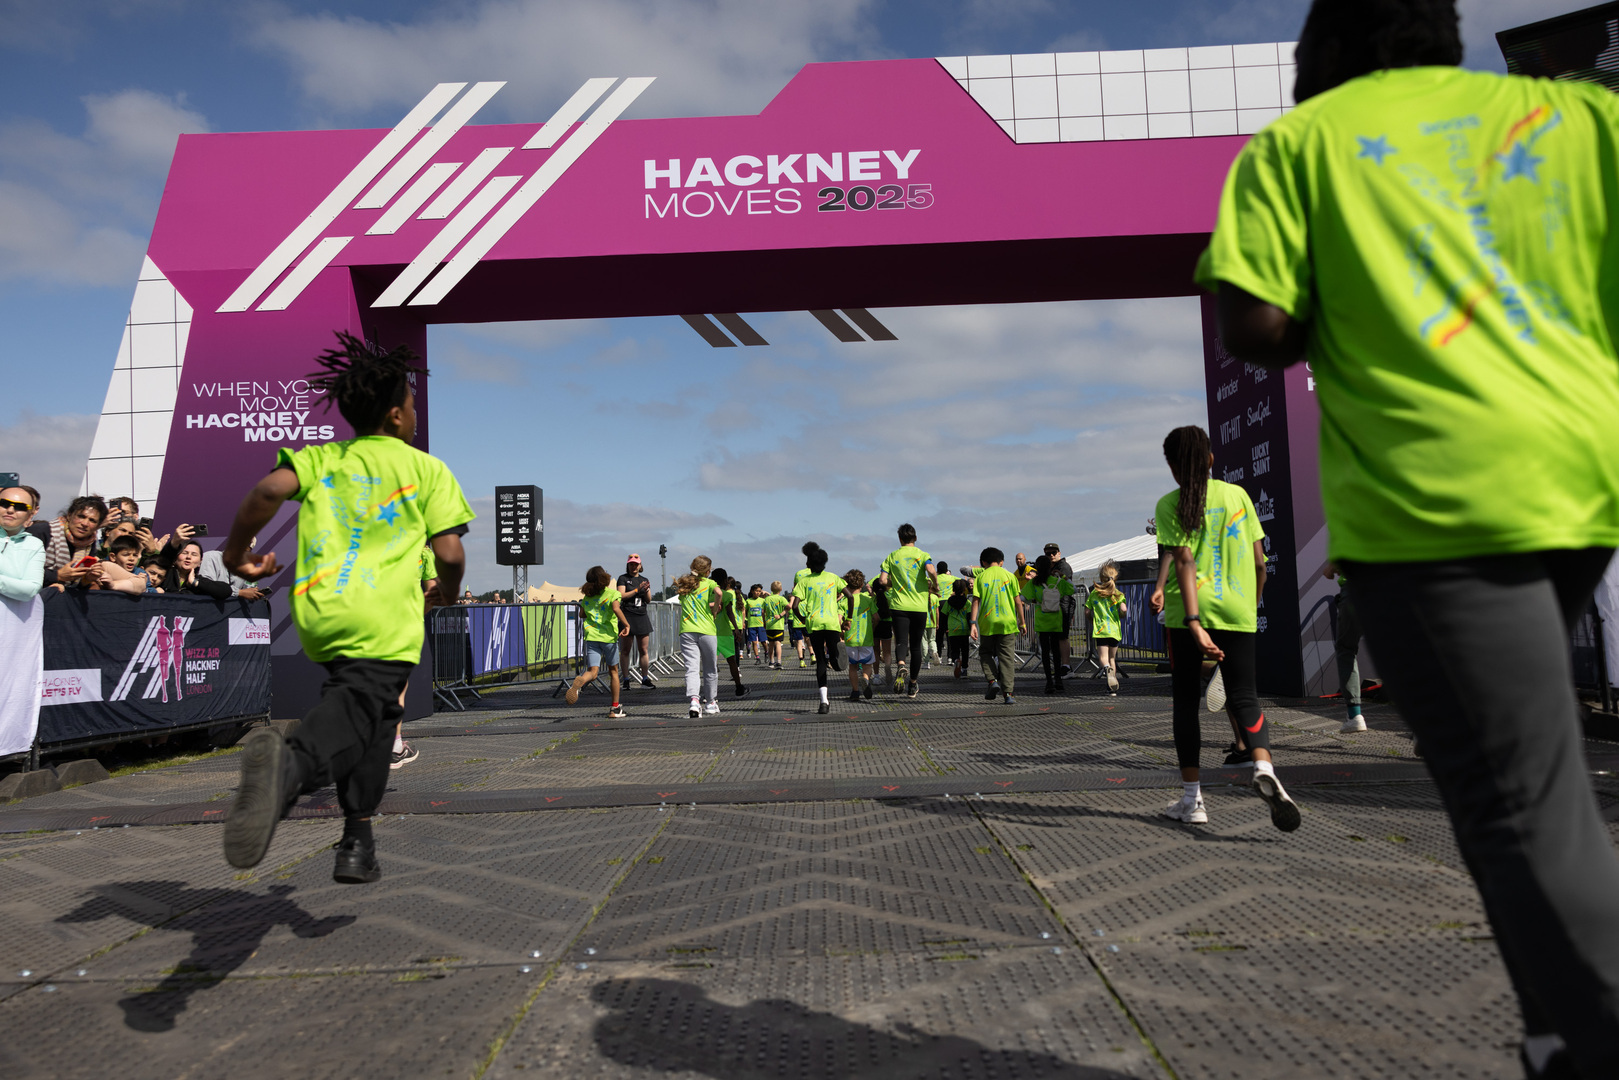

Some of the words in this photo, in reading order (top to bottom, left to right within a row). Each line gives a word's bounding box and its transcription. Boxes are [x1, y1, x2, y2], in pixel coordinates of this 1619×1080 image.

[644, 149, 922, 189] HACKNEY
[645, 187, 802, 219] MOVES
[817, 183, 935, 212] 2025
[193, 381, 269, 397] WHEN
[1221, 379, 1239, 399] tinder
[240, 396, 310, 411] MOVE
[186, 411, 310, 429] HACKNEY
[244, 425, 335, 442] MOVES
[1251, 440, 1270, 460] LUCKY
[1252, 456, 1271, 477] SAINT
[354, 485, 372, 523] RUN
[1211, 514, 1220, 542] RUN
[334, 527, 363, 595] HACKNEY
[1212, 545, 1223, 601] HACKNEY
[185, 648, 206, 659] WIZZ
[207, 648, 220, 658] AIR
[185, 659, 221, 671] HACKNEY
[41, 676, 82, 687] HACKNEY
[186, 672, 206, 684] HALF
[42, 687, 66, 697] LET'S
[68, 687, 82, 696] FLY
[186, 684, 213, 695] LONDON
